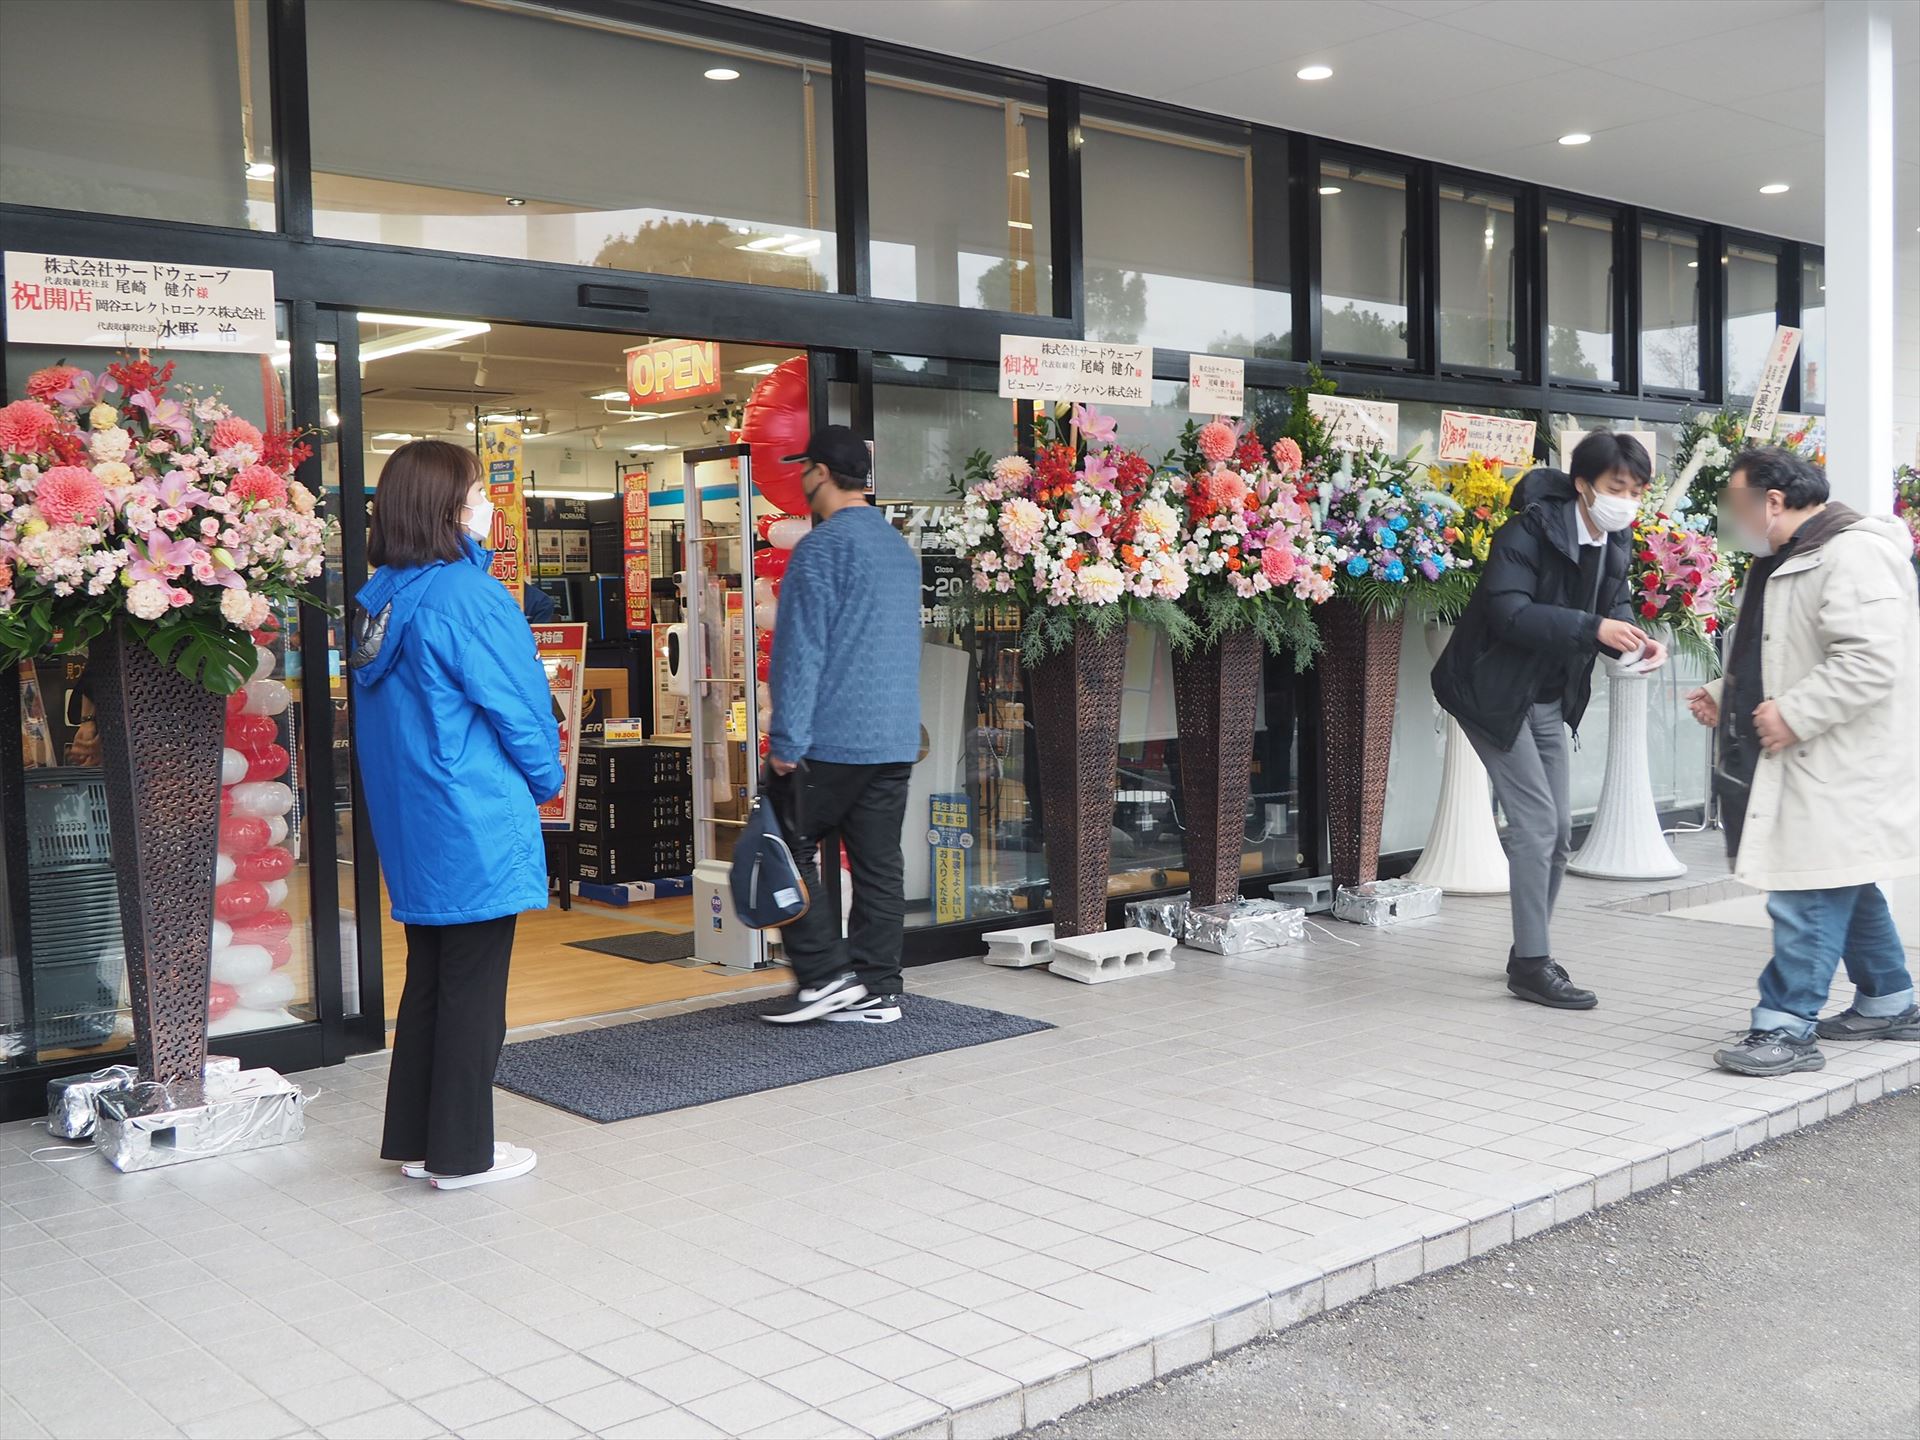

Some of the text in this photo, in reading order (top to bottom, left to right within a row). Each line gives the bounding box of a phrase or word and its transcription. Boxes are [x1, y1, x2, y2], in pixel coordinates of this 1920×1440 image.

[44, 257, 231, 284] 株式会社サードウェーブ
[11, 281, 93, 312] 祝開店
[44, 277, 109, 289] 代表取締役社長
[116, 279, 147, 295] 尾崎
[95, 299, 266, 321] 岡谷エレクトロニクス株式会社
[158, 320, 199, 338] 水野
[1041, 342, 1143, 361] 株式会社サードウェーブ
[633, 341, 714, 396] OPEN
[1004, 354, 1039, 376] 御祝
[1081, 359, 1104, 374] 尾崎
[1007, 379, 1143, 399] ビューソニックジャパン株式会社
[935, 566, 954, 574] Close
[940, 850, 948, 914] お入りください
